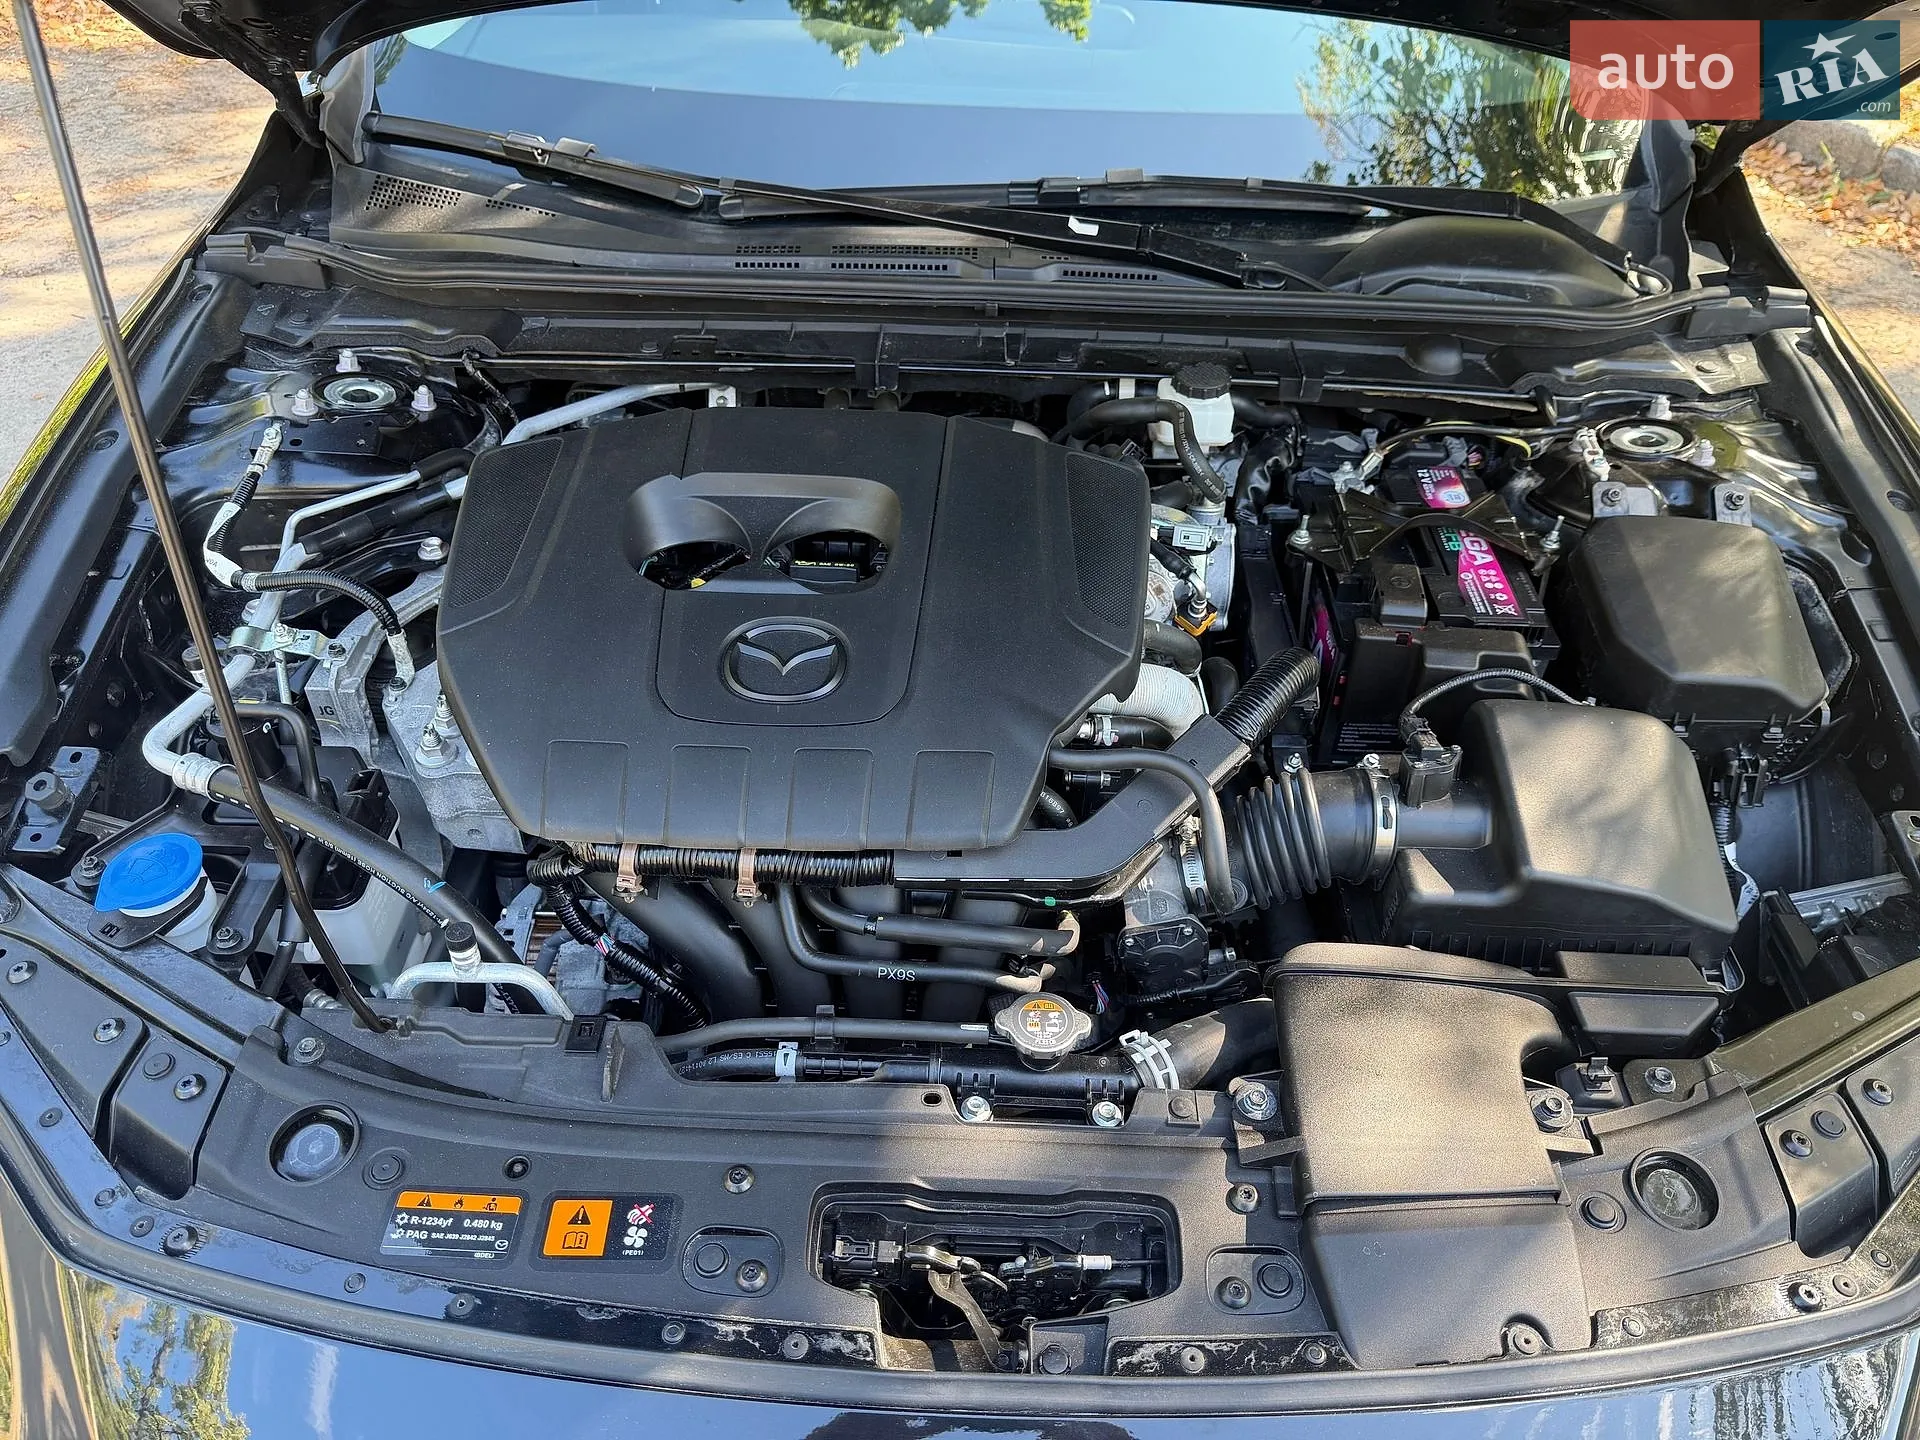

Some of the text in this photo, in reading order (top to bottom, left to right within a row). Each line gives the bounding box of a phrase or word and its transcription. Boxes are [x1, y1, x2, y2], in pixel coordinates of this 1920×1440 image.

[318, 705, 335, 716] JG
[357, 859, 376, 874] HOSE
[376, 871, 406, 894] SUCTION
[876, 966, 916, 982] PX9S
[410, 1215, 503, 1231] R-1234yf 0.480 kg
[406, 1229, 429, 1240] PAG
